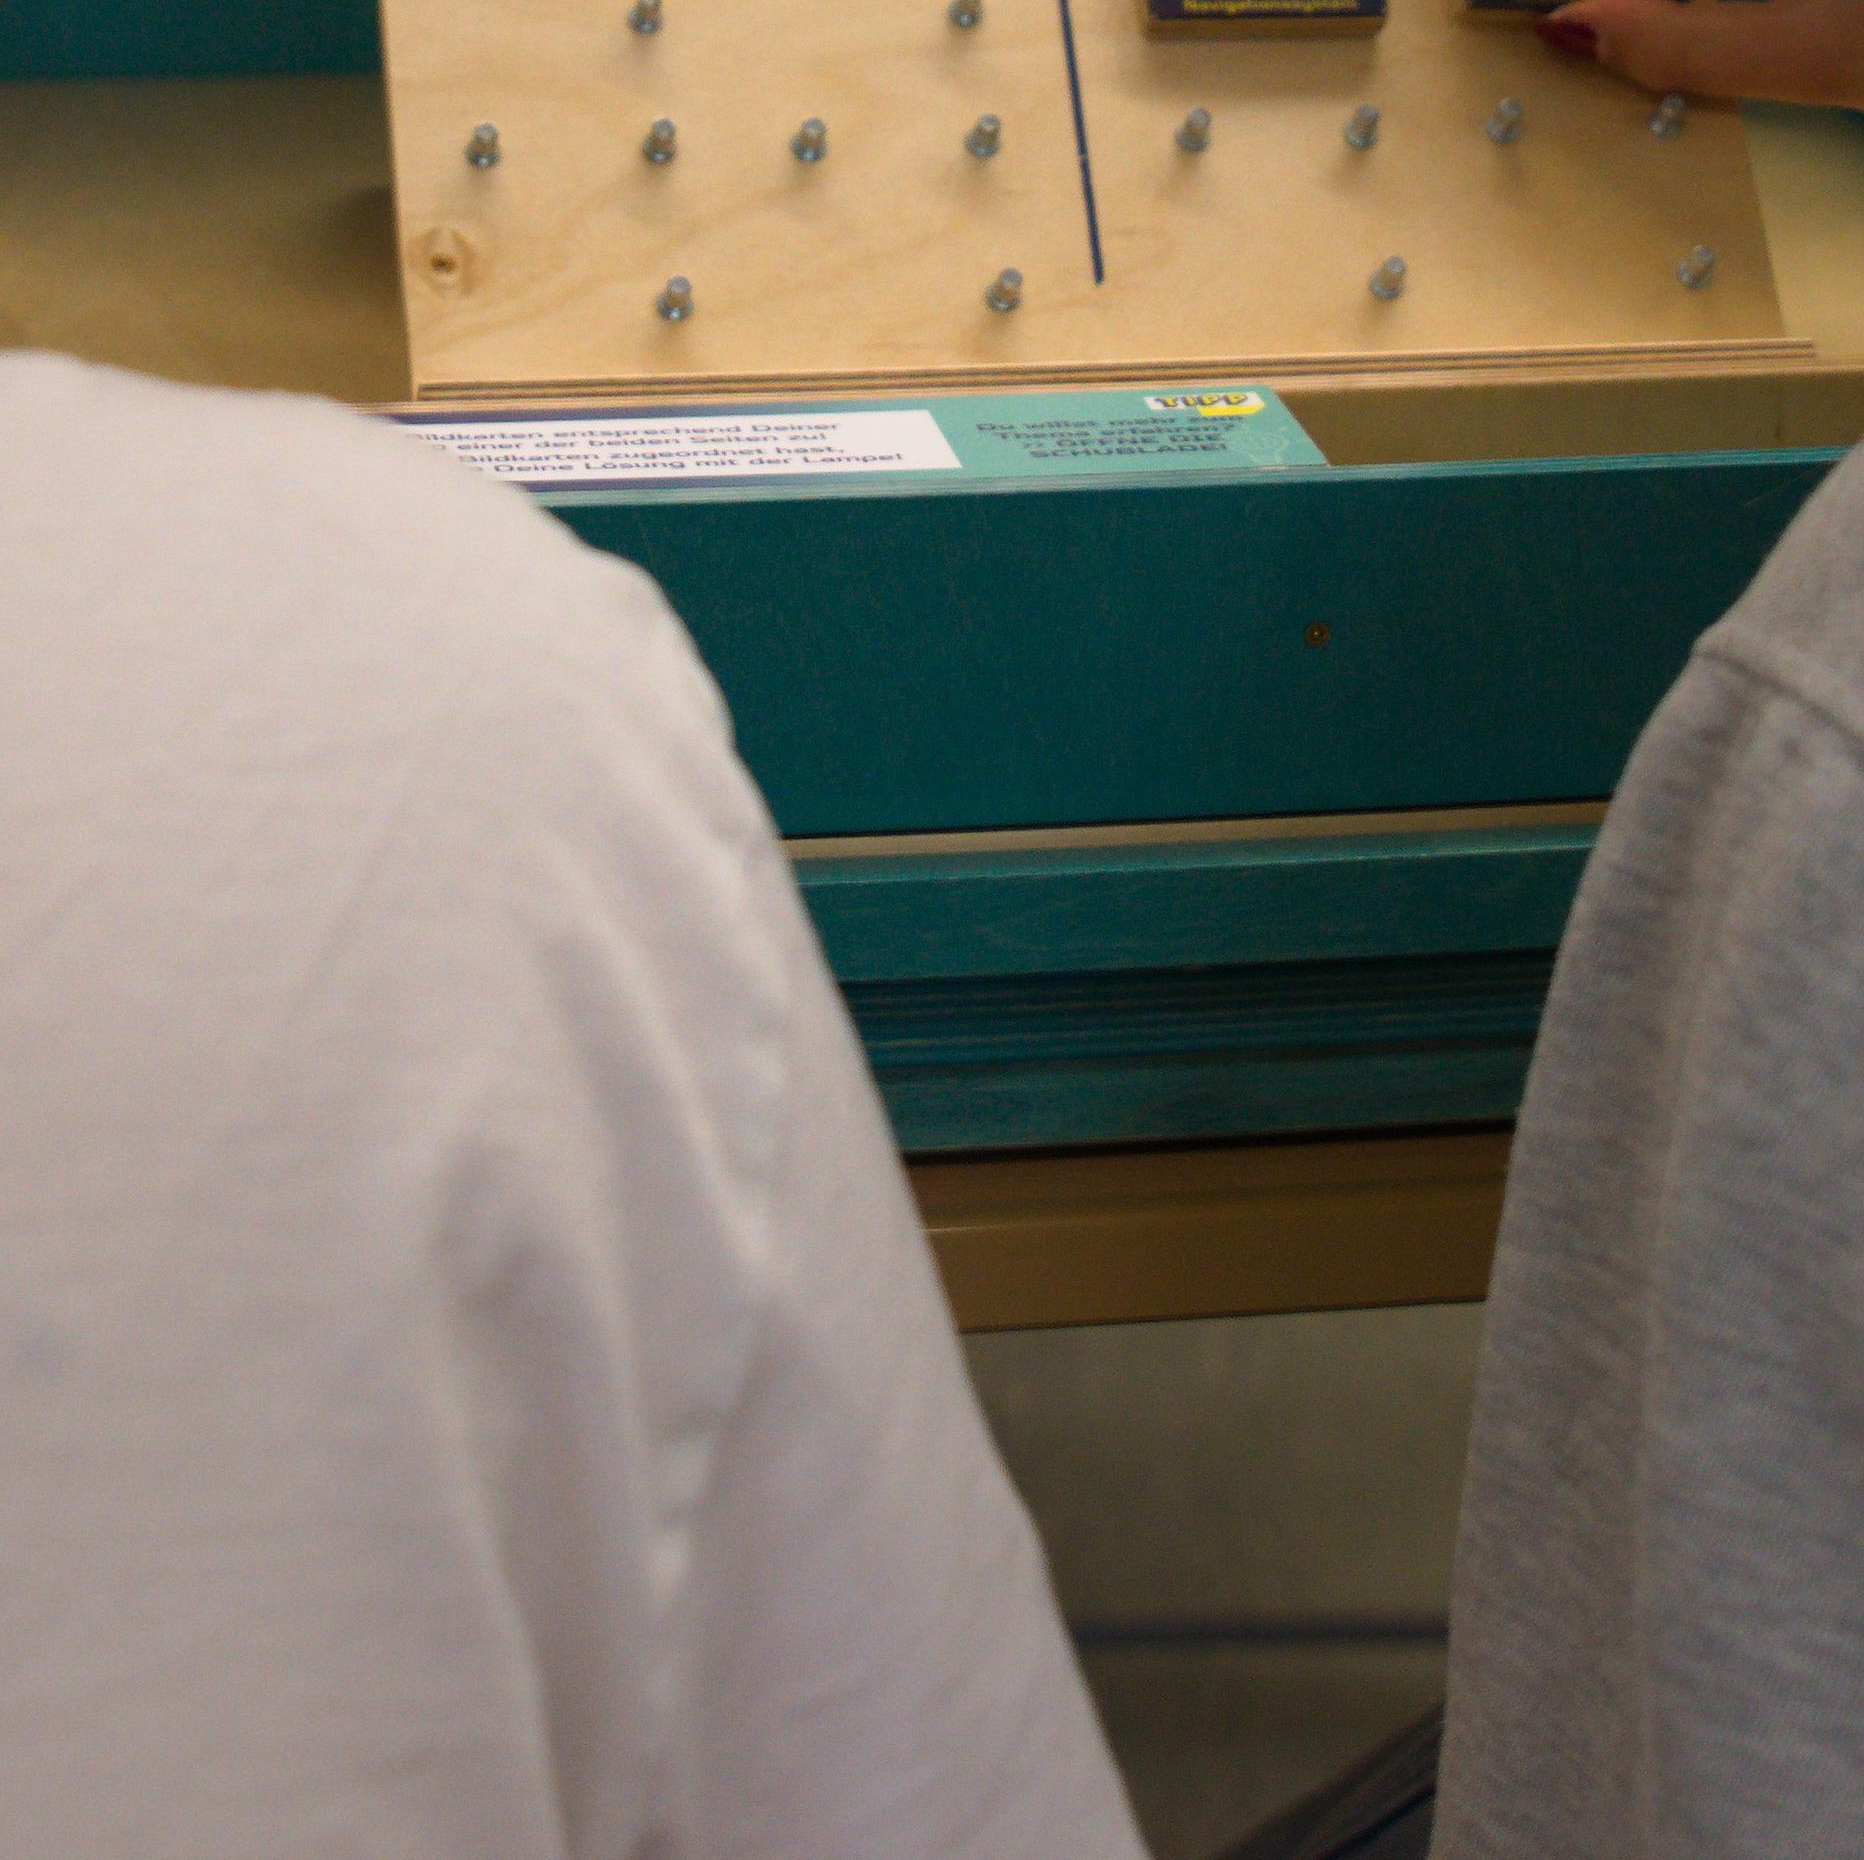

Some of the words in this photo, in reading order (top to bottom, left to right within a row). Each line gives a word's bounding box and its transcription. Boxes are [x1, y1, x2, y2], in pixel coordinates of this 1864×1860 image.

[1155, 393, 1248, 407] TIPP
[555, 425, 742, 438] entsprechend
[752, 423, 841, 431] Deiner
[589, 438, 680, 446] beiden
[610, 448, 764, 459] zugeordnet
[775, 446, 844, 454] hast,
[584, 458, 685, 469] Lösung
[695, 459, 738, 467] mit
[749, 457, 792, 465] der
[803, 453, 904, 463] Lampe!
